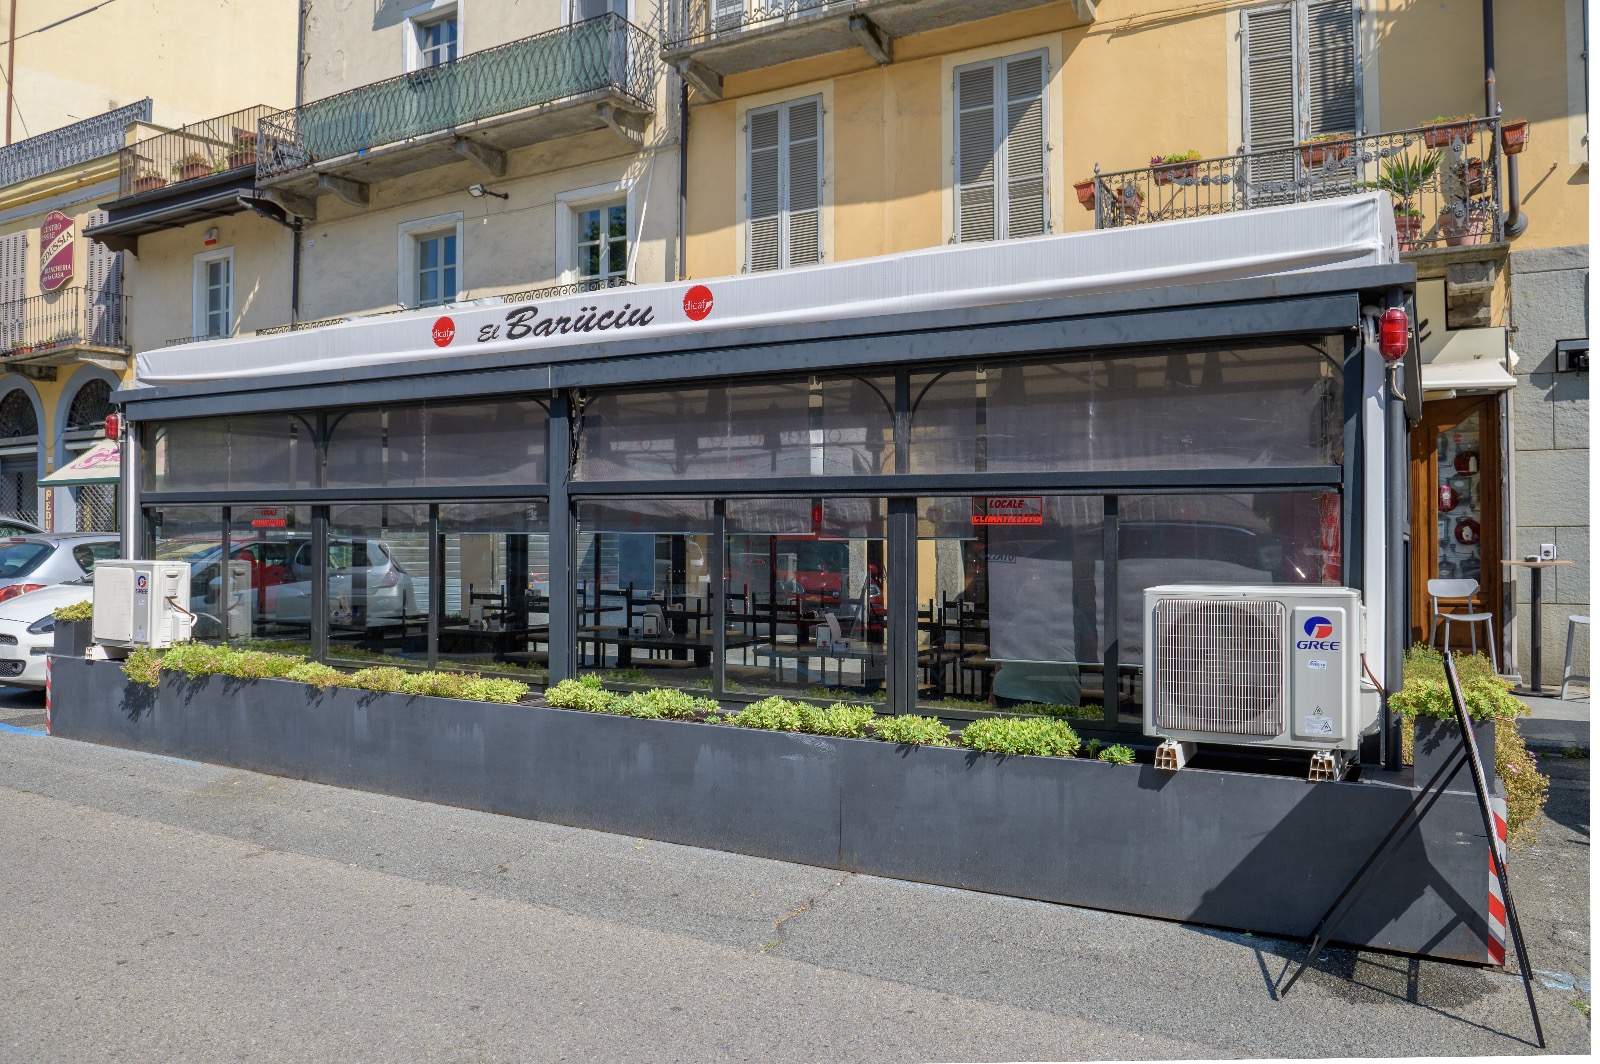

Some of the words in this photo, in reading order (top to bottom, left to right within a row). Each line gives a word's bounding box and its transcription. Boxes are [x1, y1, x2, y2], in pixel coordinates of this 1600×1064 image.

[51, 272, 65, 280] CASA
[477, 323, 501, 343] El
[505, 303, 655, 340] Barüciu
[989, 499, 1025, 509] LOCALE
[1296, 640, 1341, 651] GREE
